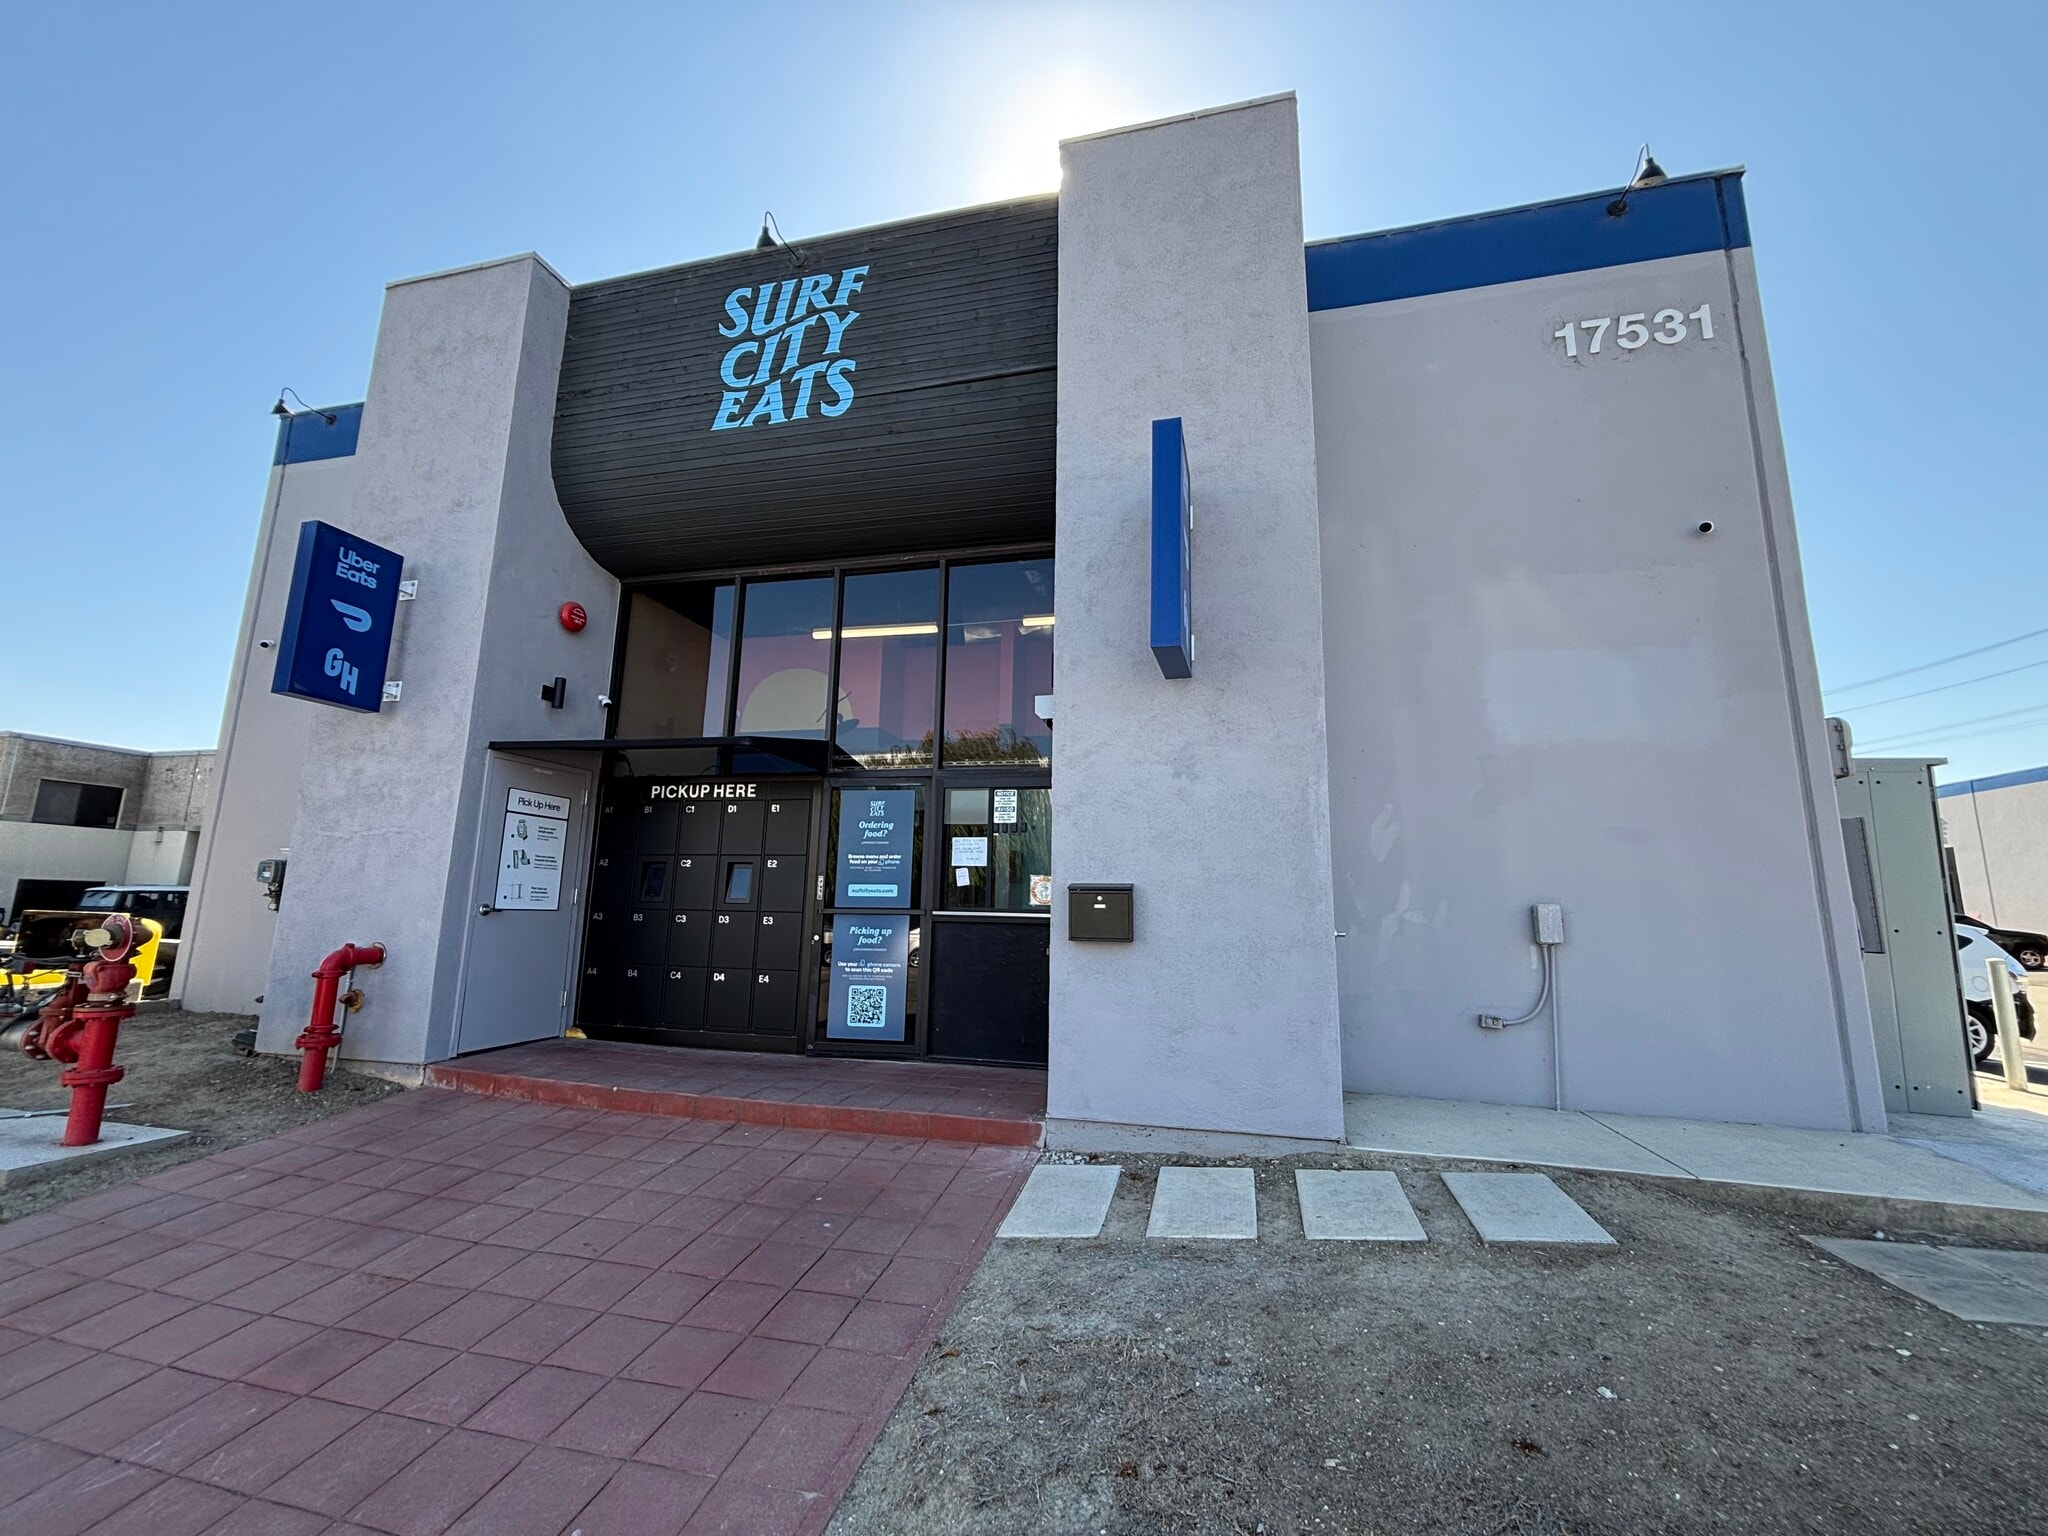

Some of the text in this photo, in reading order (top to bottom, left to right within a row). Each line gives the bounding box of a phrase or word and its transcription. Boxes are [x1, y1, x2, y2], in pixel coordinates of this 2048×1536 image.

[718, 265, 869, 338] SURF
[1554, 303, 1714, 357] 17531
[720, 310, 860, 388] CITY
[710, 358, 856, 431] EATS
[338, 546, 380, 574] Uber
[336, 562, 378, 589] Eats
[324, 647, 359, 695] GH
[651, 783, 757, 799] PICKUP HERE
[518, 796, 561, 811] Pick Up Here
[727, 804, 737, 813] D1
[771, 804, 780, 812] E1
[605, 806, 613, 814] A1
[858, 820, 894, 830] Ordering
[862, 830, 888, 840] food?
[680, 860, 692, 868] C2
[767, 860, 778, 868] E2
[676, 914, 686, 922] C3
[718, 915, 730, 924] D3
[762, 916, 774, 924] E3
[849, 926, 892, 936] Picking up
[856, 936, 883, 946] food?
[628, 969, 638, 977] B4
[670, 971, 682, 979] C4
[713, 972, 725, 982] D4
[758, 975, 770, 983] E4
